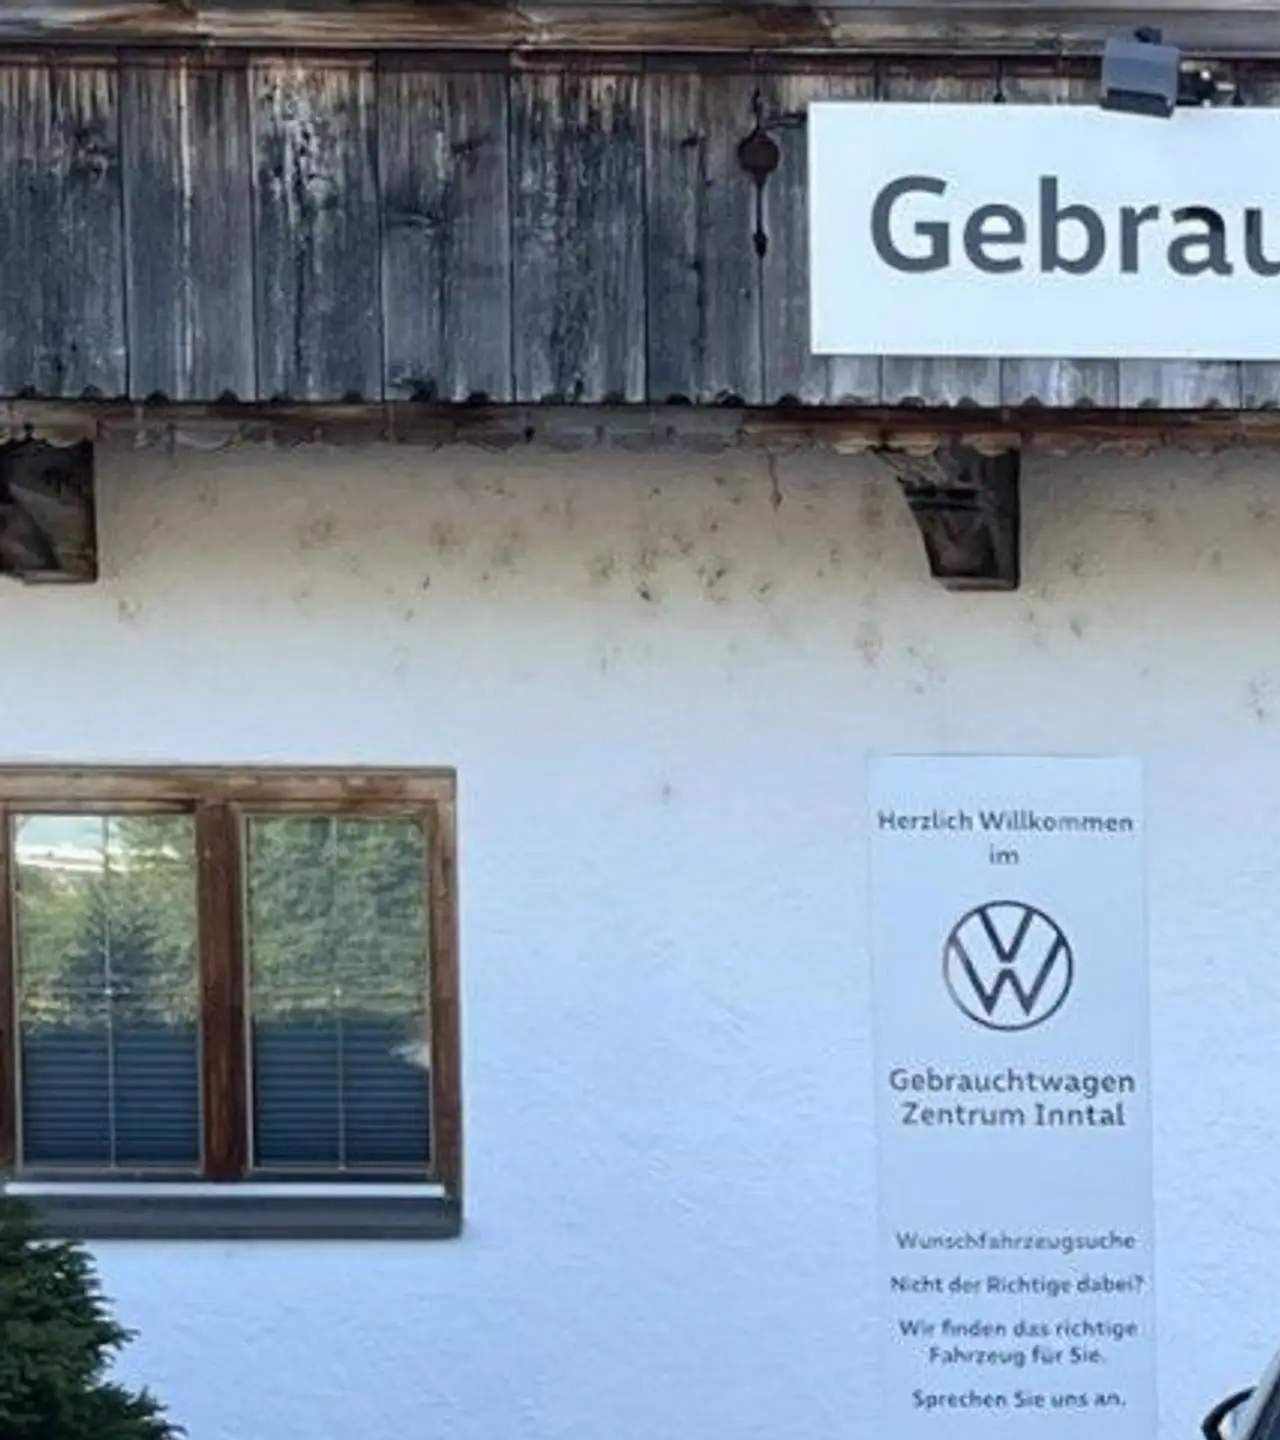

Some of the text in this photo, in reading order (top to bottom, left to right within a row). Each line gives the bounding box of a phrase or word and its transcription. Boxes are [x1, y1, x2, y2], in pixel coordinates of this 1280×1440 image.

[878, 810, 1134, 832] Herzlich Willkommen
[990, 844, 1019, 865] im
[943, 899, 1073, 1032] VW
[889, 1067, 1136, 1098] Gebrauchtwagen
[901, 1101, 1126, 1127] Zentrum Inntal
[897, 1230, 1136, 1253] Wunschfahrzeugsuche
[890, 1273, 1145, 1297] Nicht der Richtige dabei?
[900, 1319, 1138, 1340] Wir finden das richtige
[928, 1346, 1026, 1367] Fahrzeug
[1031, 1345, 1063, 1364] für
[912, 1389, 1128, 1409] Sprechen Sie uns an.
